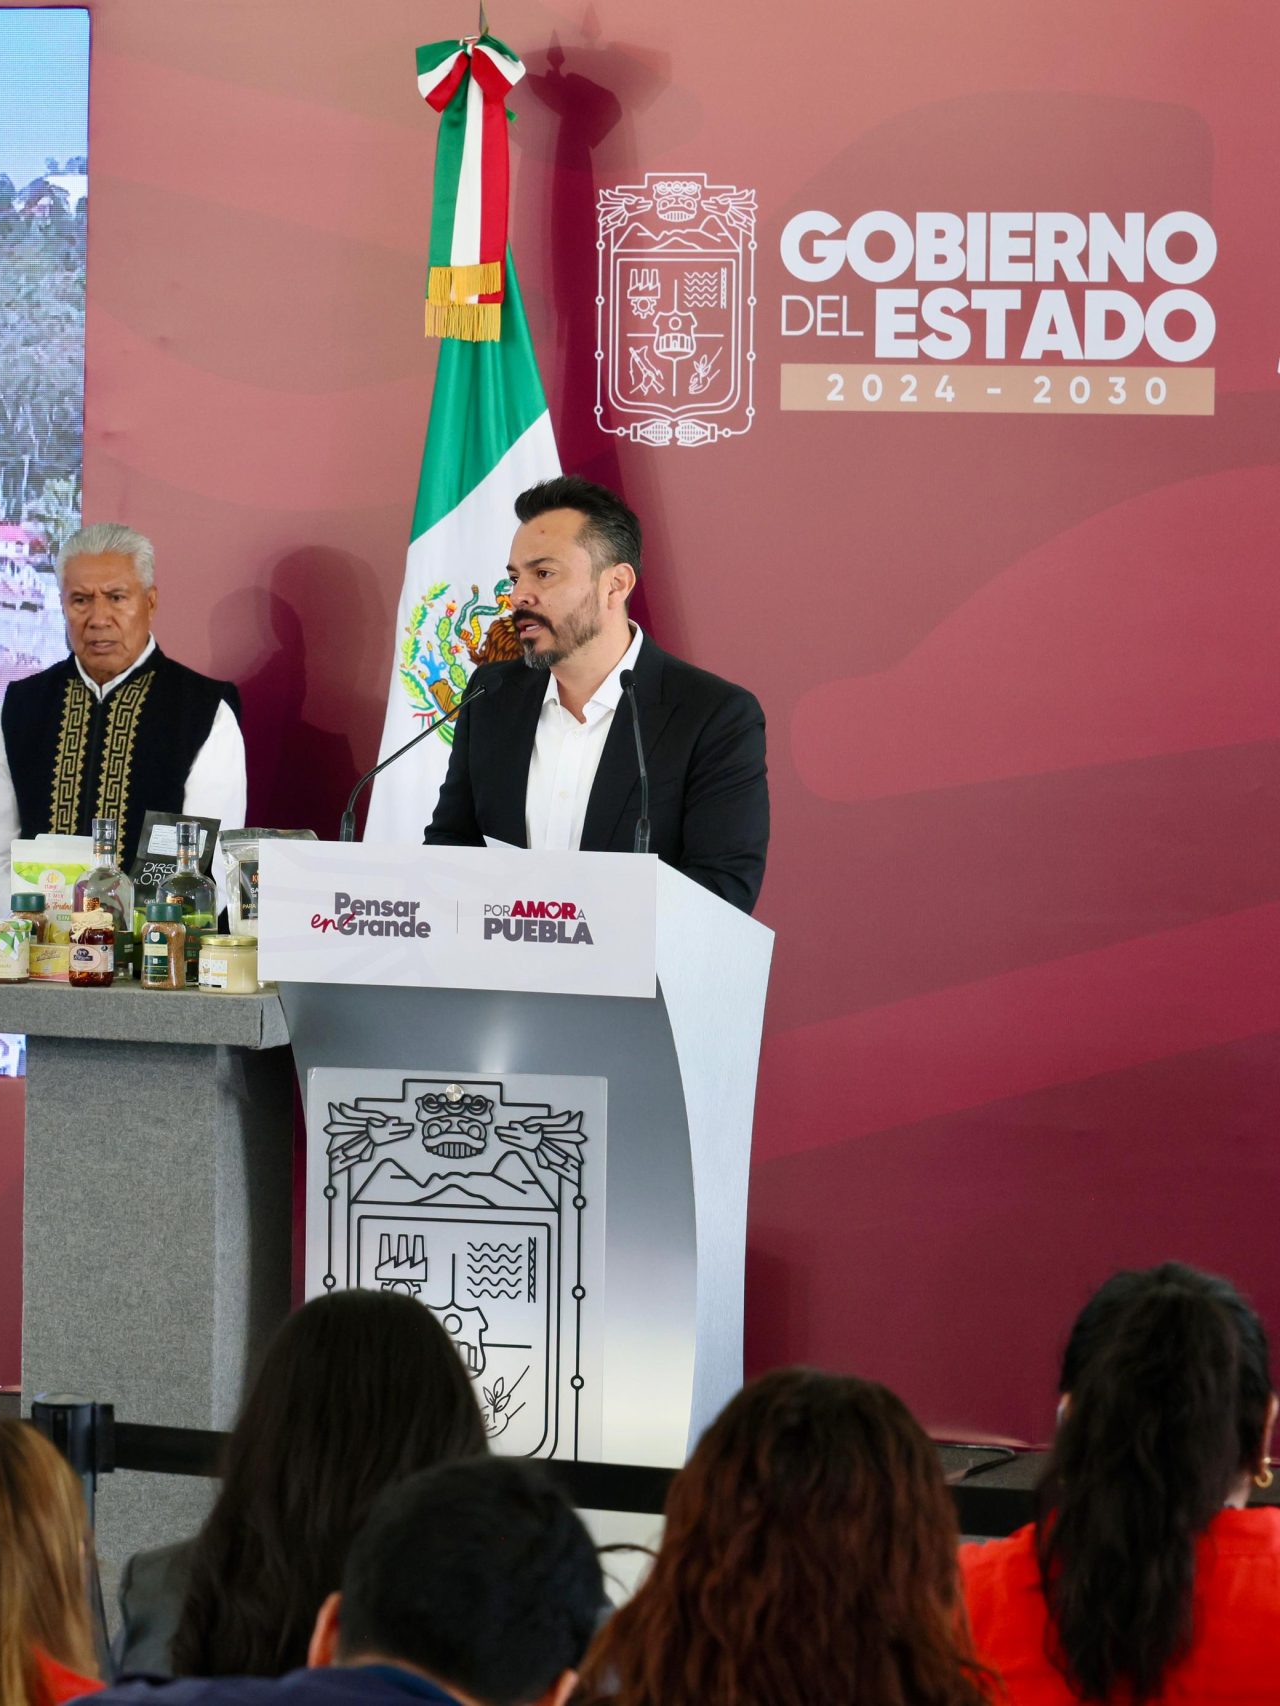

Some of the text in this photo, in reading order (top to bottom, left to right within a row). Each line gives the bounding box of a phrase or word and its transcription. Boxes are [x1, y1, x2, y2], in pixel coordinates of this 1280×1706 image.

[780, 210, 1218, 284] GOBIERNO
[781, 287, 1217, 362] DEL ESTADO
[826, 373, 956, 402] 2024
[1033, 375, 1168, 404] 2030
[143, 862, 178, 874] DIREC
[334, 892, 421, 917] Pensar
[484, 900, 587, 920] POR AMOR A
[311, 912, 431, 938] en Grande
[483, 917, 594, 945] PUEBLA
